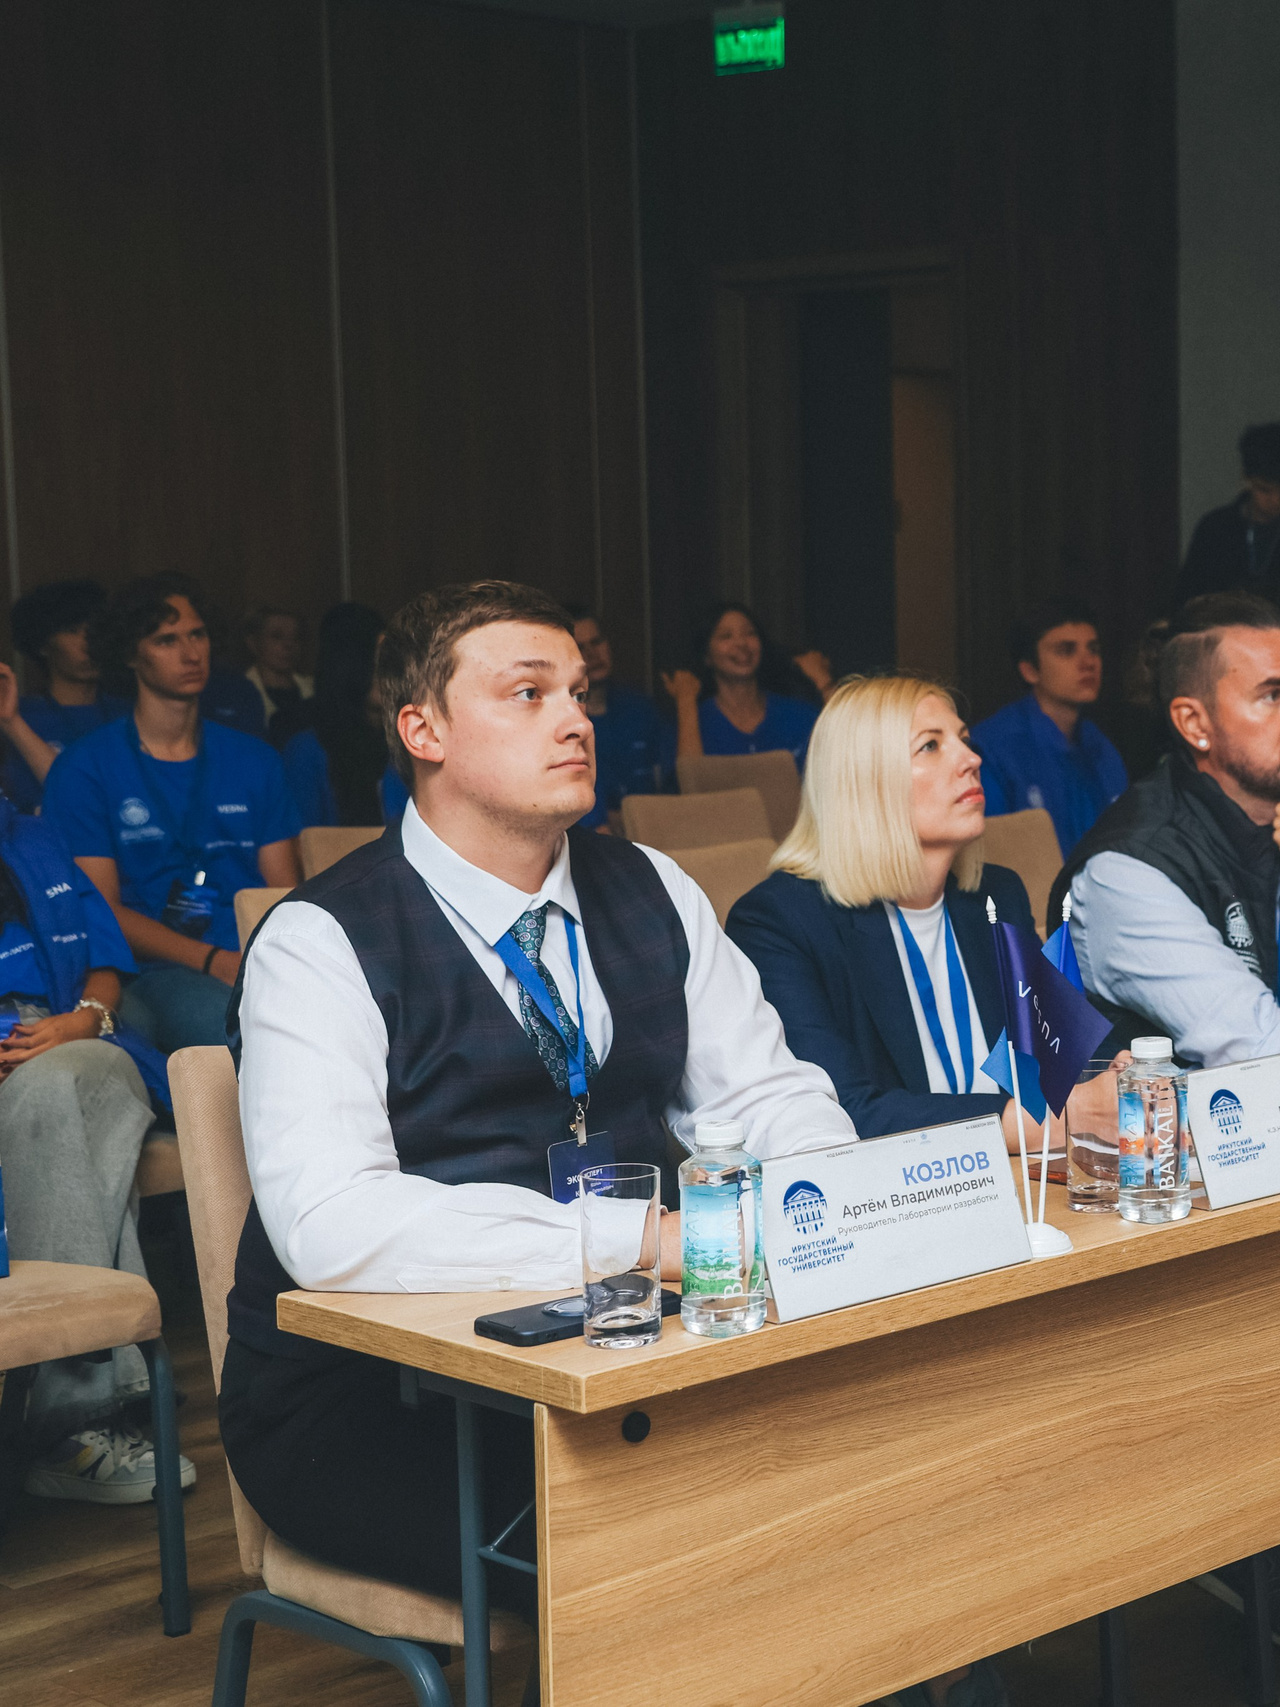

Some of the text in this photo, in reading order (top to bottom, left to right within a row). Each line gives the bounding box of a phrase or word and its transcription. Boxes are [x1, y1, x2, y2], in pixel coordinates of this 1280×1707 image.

[45, 882, 72, 898] SNA
[1158, 1105, 1176, 1190] BAIKAL
[1207, 1142, 1266, 1163] ГОСУДАРСТВЕННЫЙ
[1217, 1137, 1253, 1151] ИРКУТСКИЙ
[902, 1150, 991, 1186] КОЗЛОВ
[1218, 1152, 1260, 1168] УНИВЕРСИТЕТ
[842, 1175, 995, 1219] Артём Владимирович
[837, 1192, 999, 1236] Руководитель Лаборатории разработки
[723, 1200, 744, 1300] BAIKAL
[777, 1241, 855, 1267] ГОСУДАРСТВЕННЫЙ
[791, 1235, 837, 1254] ИРКУТСКИЙ
[791, 1253, 846, 1274] УНИВЕРСИТЕТ
